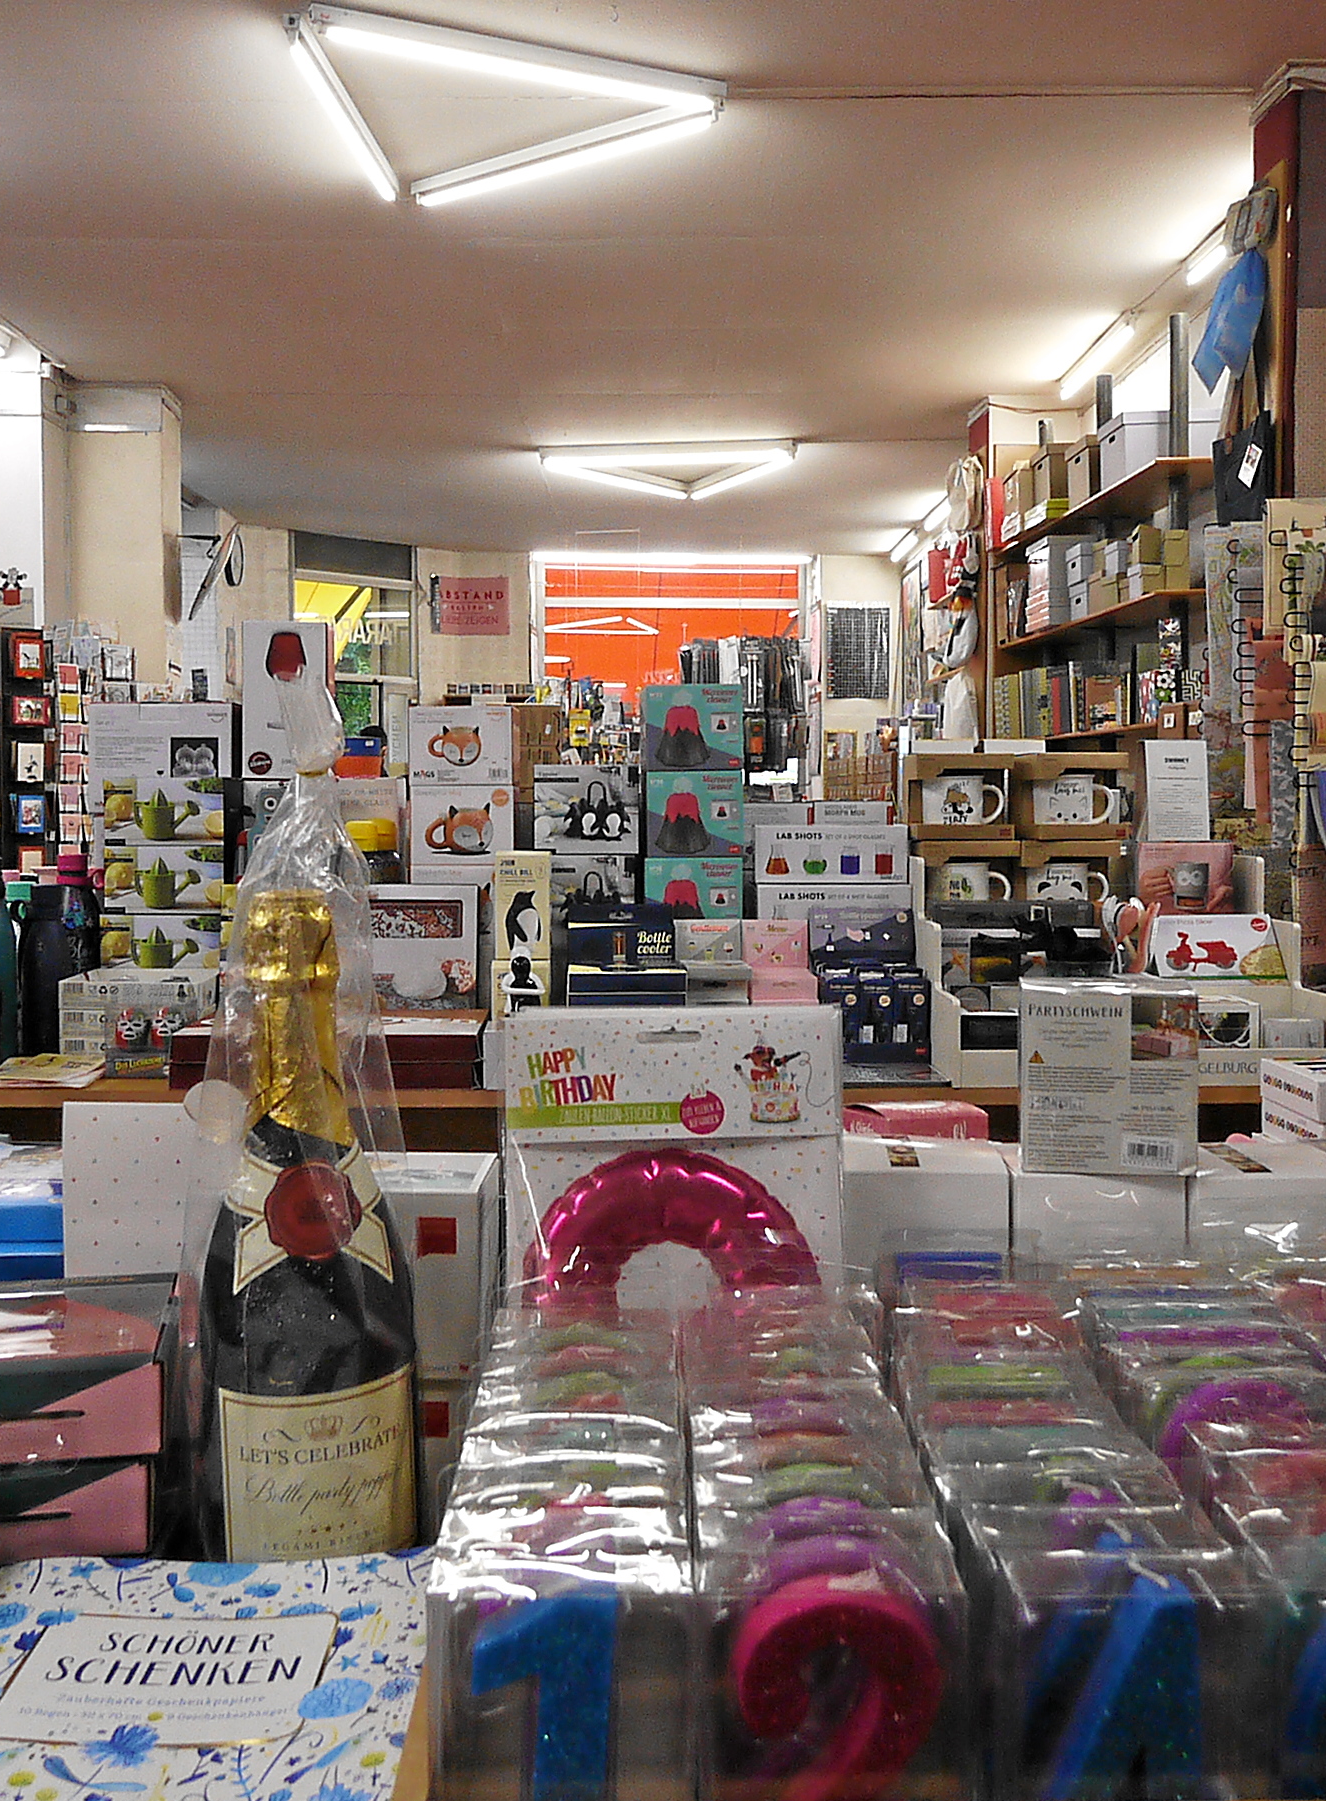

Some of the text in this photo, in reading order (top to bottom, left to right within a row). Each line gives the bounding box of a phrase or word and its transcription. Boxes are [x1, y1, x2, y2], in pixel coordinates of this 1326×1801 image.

[795, 832, 823, 840] SHOTS
[637, 931, 672, 944] Bottle
[637, 943, 672, 955] cooler
[1028, 1003, 1123, 1018] PARTYSCHWEIN
[527, 1046, 586, 1079] HAPPY
[519, 1073, 617, 1115] BIRTHDAY
[240, 1446, 289, 1465] LET'S
[99, 1627, 276, 1656] SCHÖNER
[45, 1654, 303, 1687] SCHENKEN
